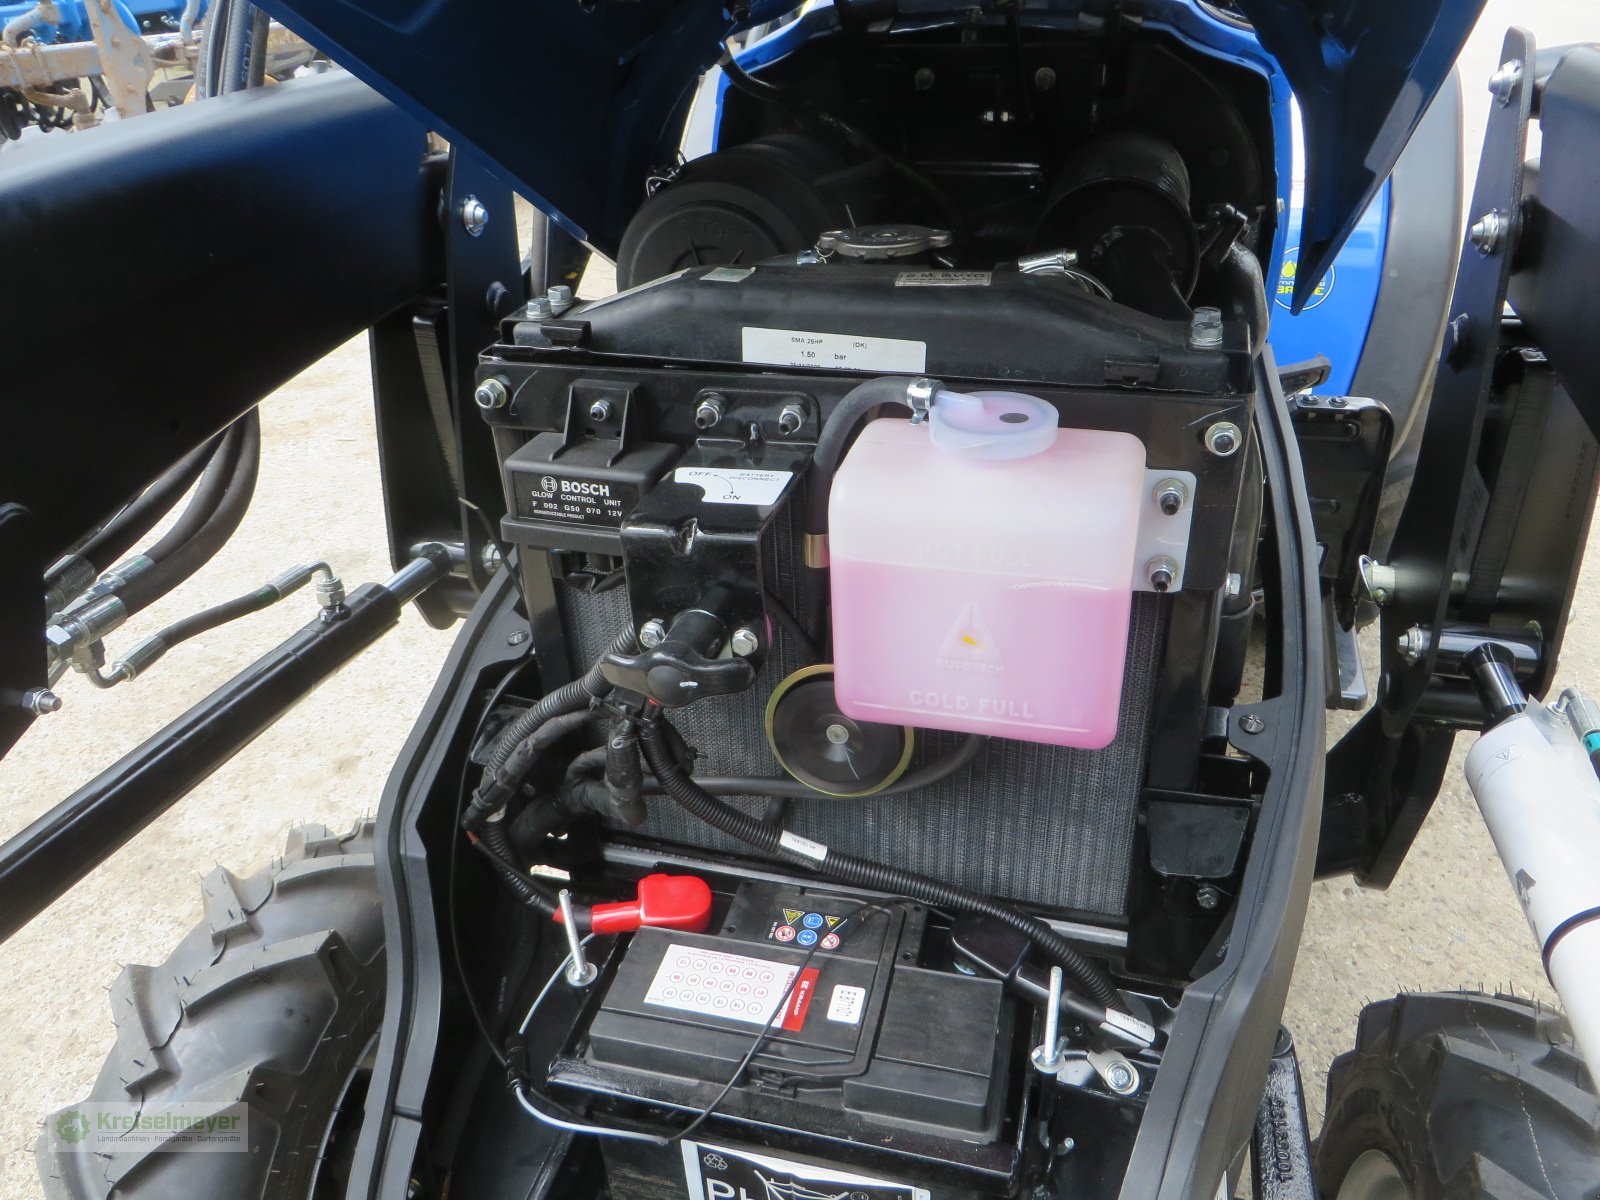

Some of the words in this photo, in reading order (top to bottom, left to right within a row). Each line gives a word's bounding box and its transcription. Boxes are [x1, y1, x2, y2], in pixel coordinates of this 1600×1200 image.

[834, 352, 847, 360] bar
[560, 480, 610, 497] BOSCH
[531, 490, 554, 499] GLOW
[560, 494, 597, 504] CONTROL
[603, 498, 622, 507] UNIT
[543, 502, 558, 510] 002
[564, 504, 580, 513] G50
[586, 507, 601, 515] 070
[607, 509, 623, 517] 12V
[909, 689, 970, 710] COLD
[977, 696, 1035, 719] FULL
